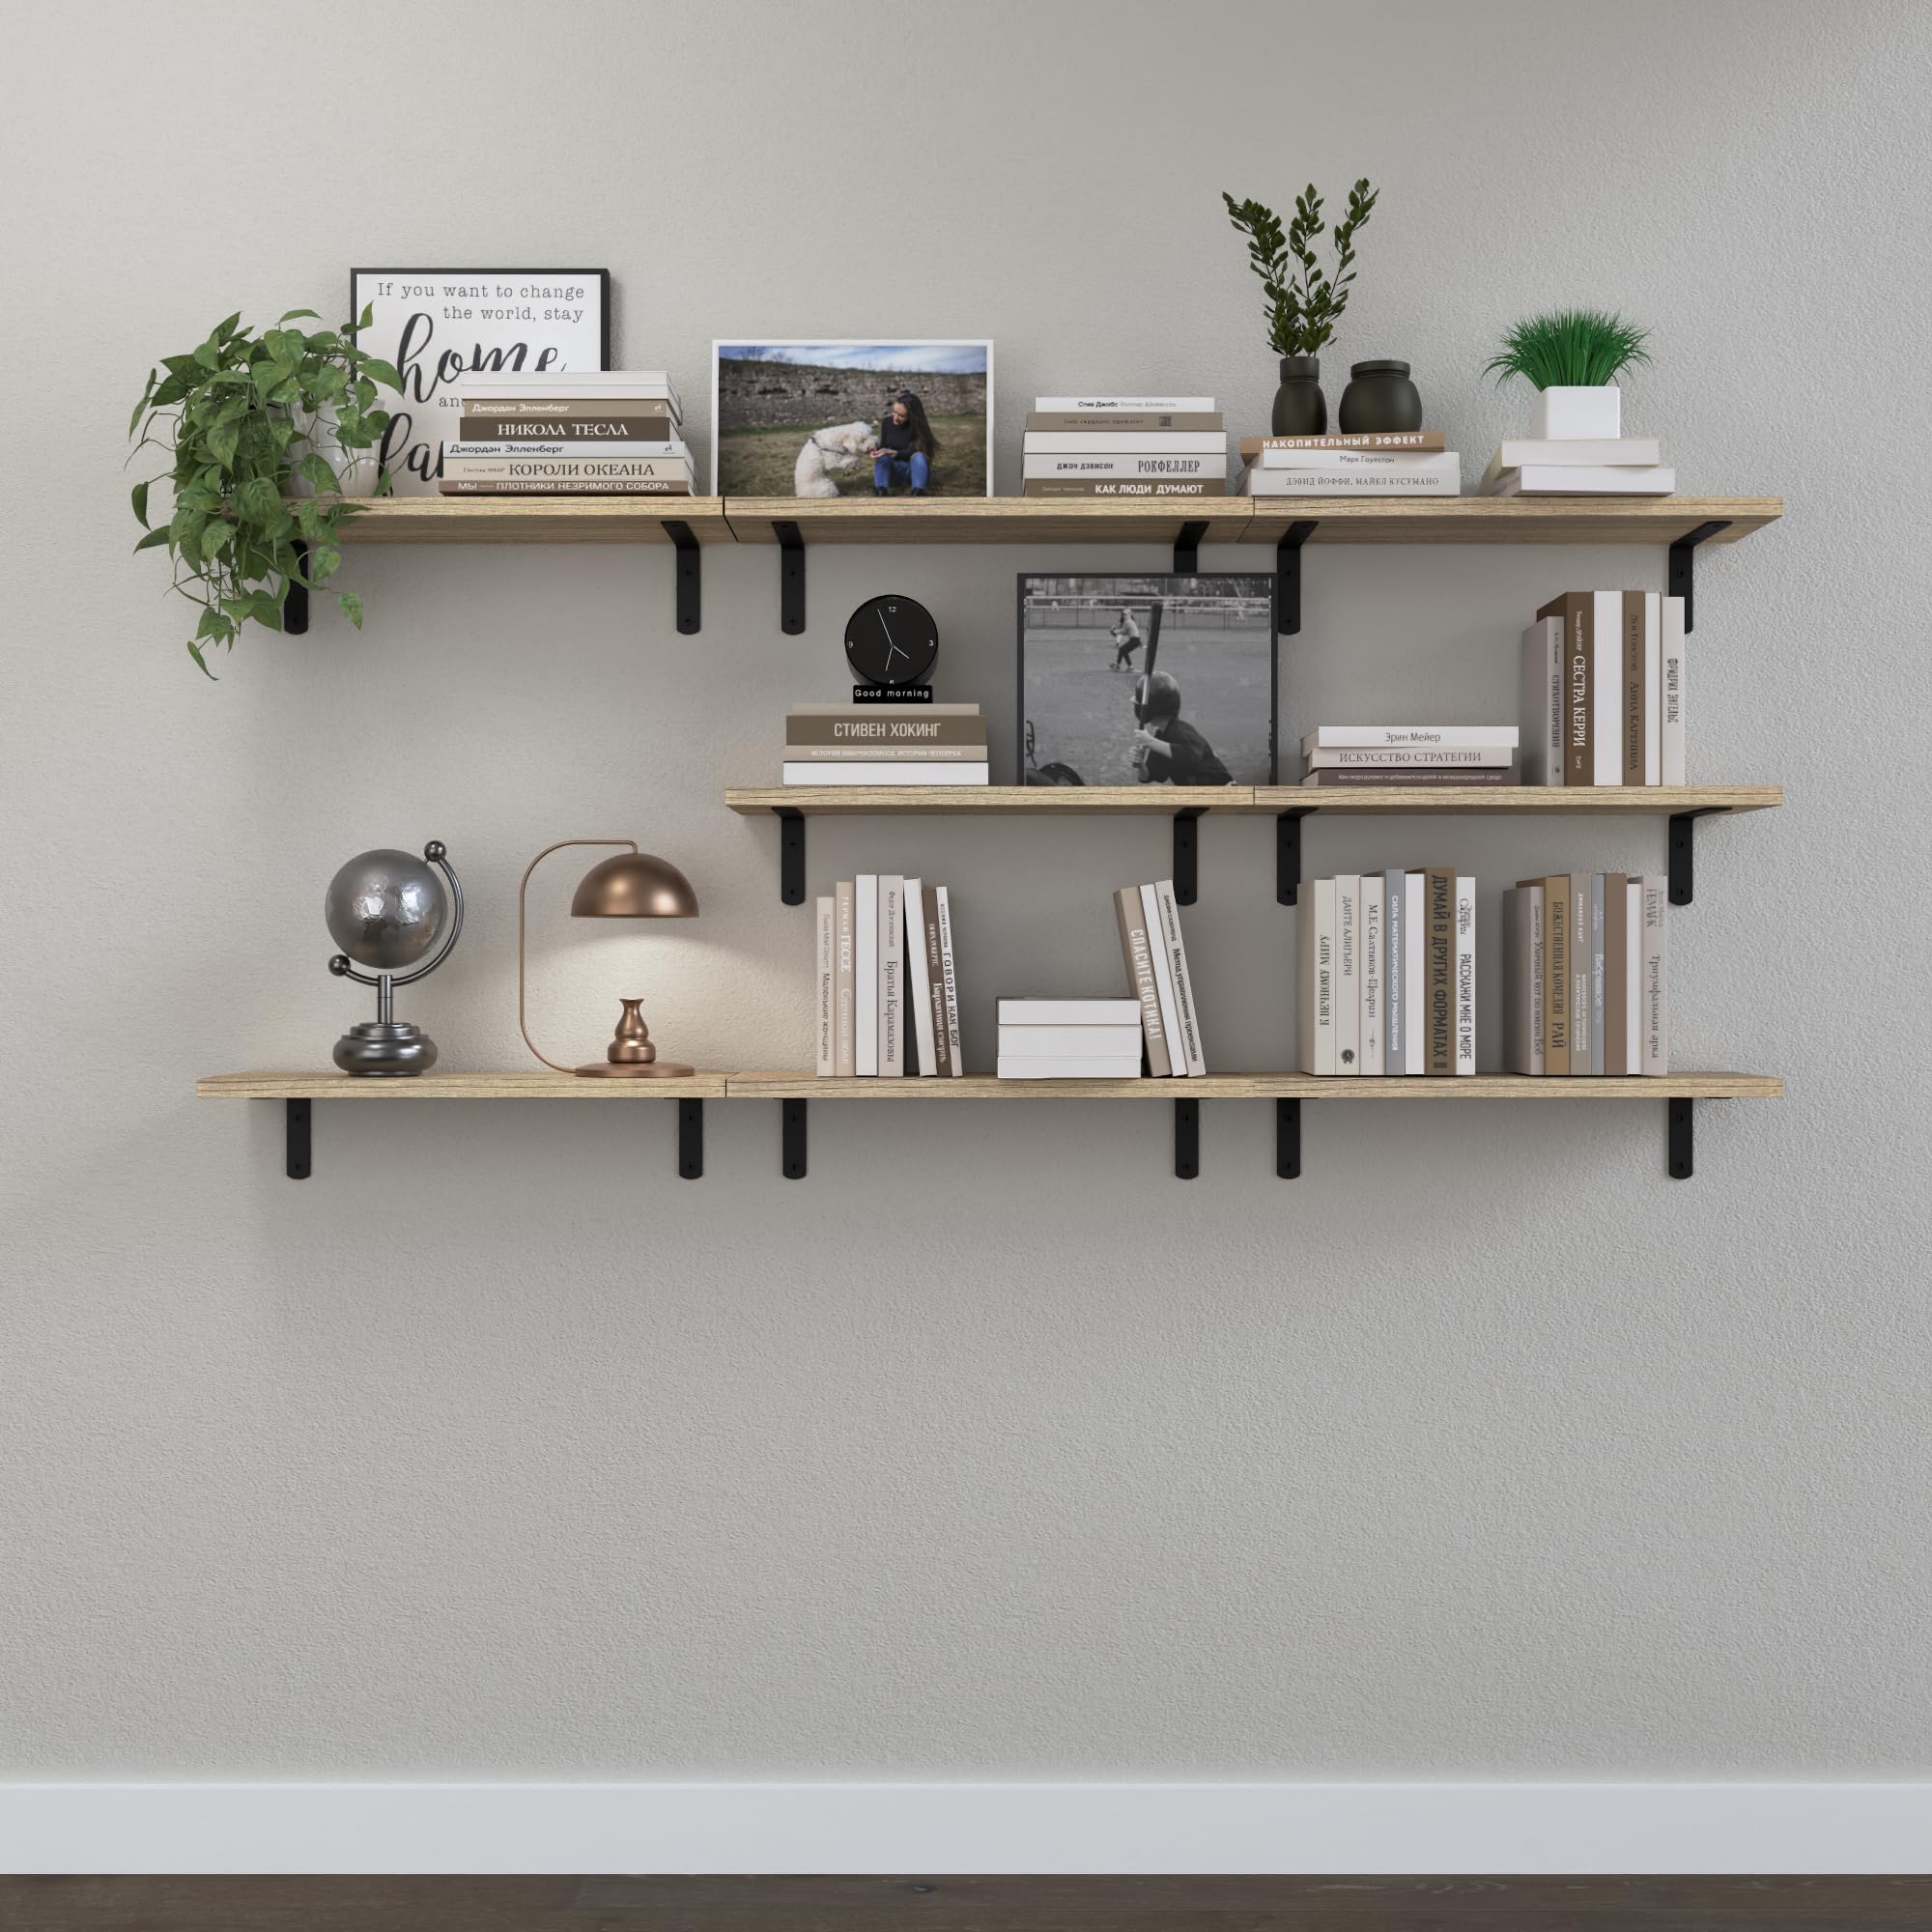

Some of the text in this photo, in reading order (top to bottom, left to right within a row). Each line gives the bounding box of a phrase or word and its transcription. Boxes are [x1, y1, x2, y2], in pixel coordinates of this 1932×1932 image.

[378, 282, 584, 301] If you want to change
[443, 306, 583, 324] the world, stay
[471, 404, 569, 413] Джордан Элленберг
[497, 424, 629, 436] НИКОЛА ТЕСЛА
[1263, 435, 1424, 448] НАКОПИТЕЛЬНЫЙ ЭФФЕКТ
[450, 444, 564, 455] Джордан Элленберг
[509, 464, 655, 477] КОРОЛИ ОКЕАНА
[1138, 460, 1200, 472] РОКФЕЛЛЕР
[458, 482, 669, 491] МЫ ПЛОТНИКИ НЕЗРИМОГО СОБОРА
[1094, 484, 1116, 494] КАК
[1119, 484, 1151, 495] ЛЮДИ
[1156, 484, 1204, 495] ДУМАЮТ
[1286, 477, 1316, 486] ДЭВИД
[1355, 476, 1387, 486] МАЙКЛ
[1389, 477, 1439, 486] КУСУМАНО
[854, 689, 929, 698] Good morning
[1573, 655, 1586, 747] СЕСТРА КЕРРИ
[1551, 674, 1560, 748] СТИХОТВОРЕНИЯ
[834, 723, 941, 737] СТИВЕН ХОКИНГ
[1385, 731, 1441, 744] Эрин Мейер
[1340, 753, 1482, 762] ИСКУССТВО СТРАТЕГИИ
[1432, 875, 1450, 920] ДУМАЙ
[1343, 895, 1352, 976] ДАНТЕ АЛИГЬЕРИ
[840, 934, 851, 973] ГЕССЕ
[1130, 929, 1152, 983] СПАСИТЕ
[1320, 935, 1330, 966] МИРУ
[1432, 936, 1448, 985] ДРУГИХ
[1552, 901, 1564, 1014] БОЖЕСТВЕННАЯ КОМЕДИЯ
[1366, 926, 1378, 1018] Салтыков-Щедрин
[1460, 953, 1472, 1002] РАССКАЖИ
[943, 952, 959, 1047] ГОВОРИ КАК БОГ
[1320, 969, 1330, 1017] ВЕЧНОМУ
[1648, 953, 1661, 1059] Триумфальная арка
[884, 960, 898, 1063] Братья Карамазовы
[1433, 989, 1448, 1057] ФОРМАТАХ
[1460, 1004, 1472, 1024] МНЕ
[1460, 1035, 1472, 1060] МОРЕ
[1551, 1022, 1565, 1049] РАЙ
